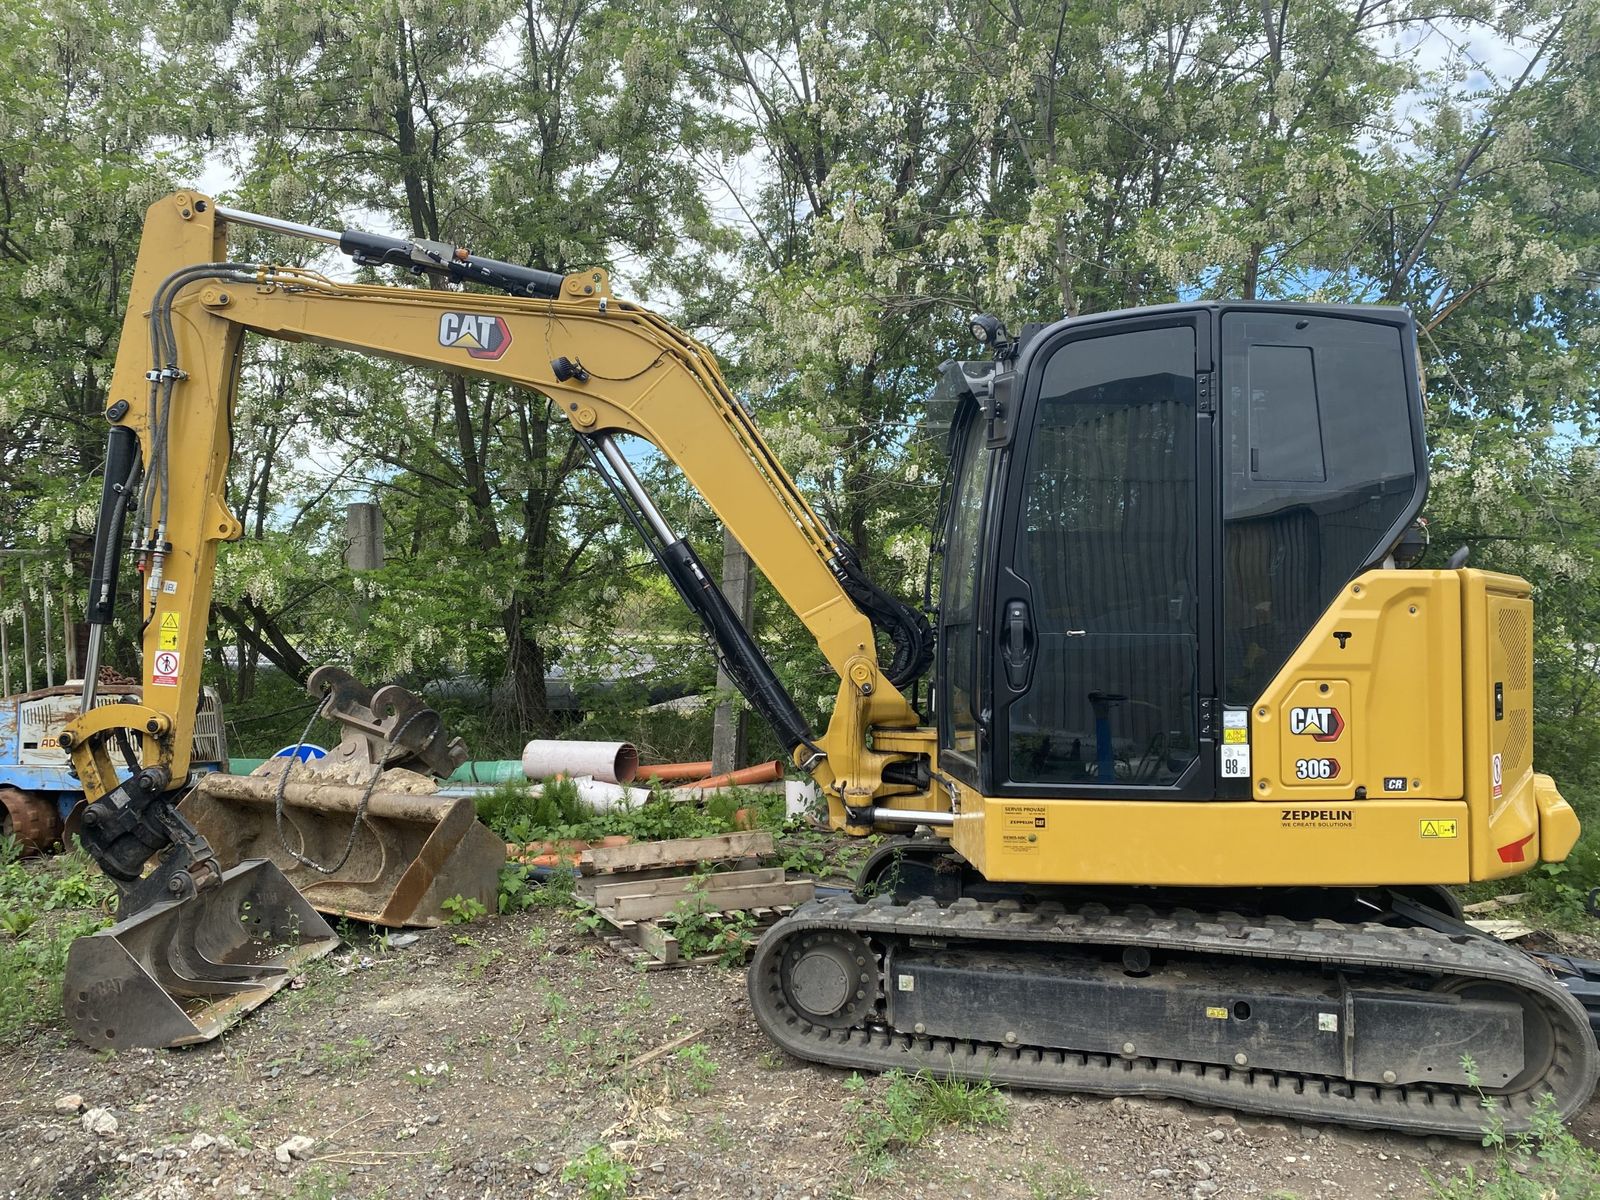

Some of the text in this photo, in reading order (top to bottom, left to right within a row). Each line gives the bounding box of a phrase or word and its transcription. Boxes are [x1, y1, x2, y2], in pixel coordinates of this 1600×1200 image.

[439, 312, 496, 350] CAT
[1290, 707, 1332, 735] CAT
[1225, 758, 1238, 774] 98
[1296, 759, 1331, 779] 306
[1388, 779, 1404, 789] CR
[1281, 810, 1352, 821] ZEPPELIN
